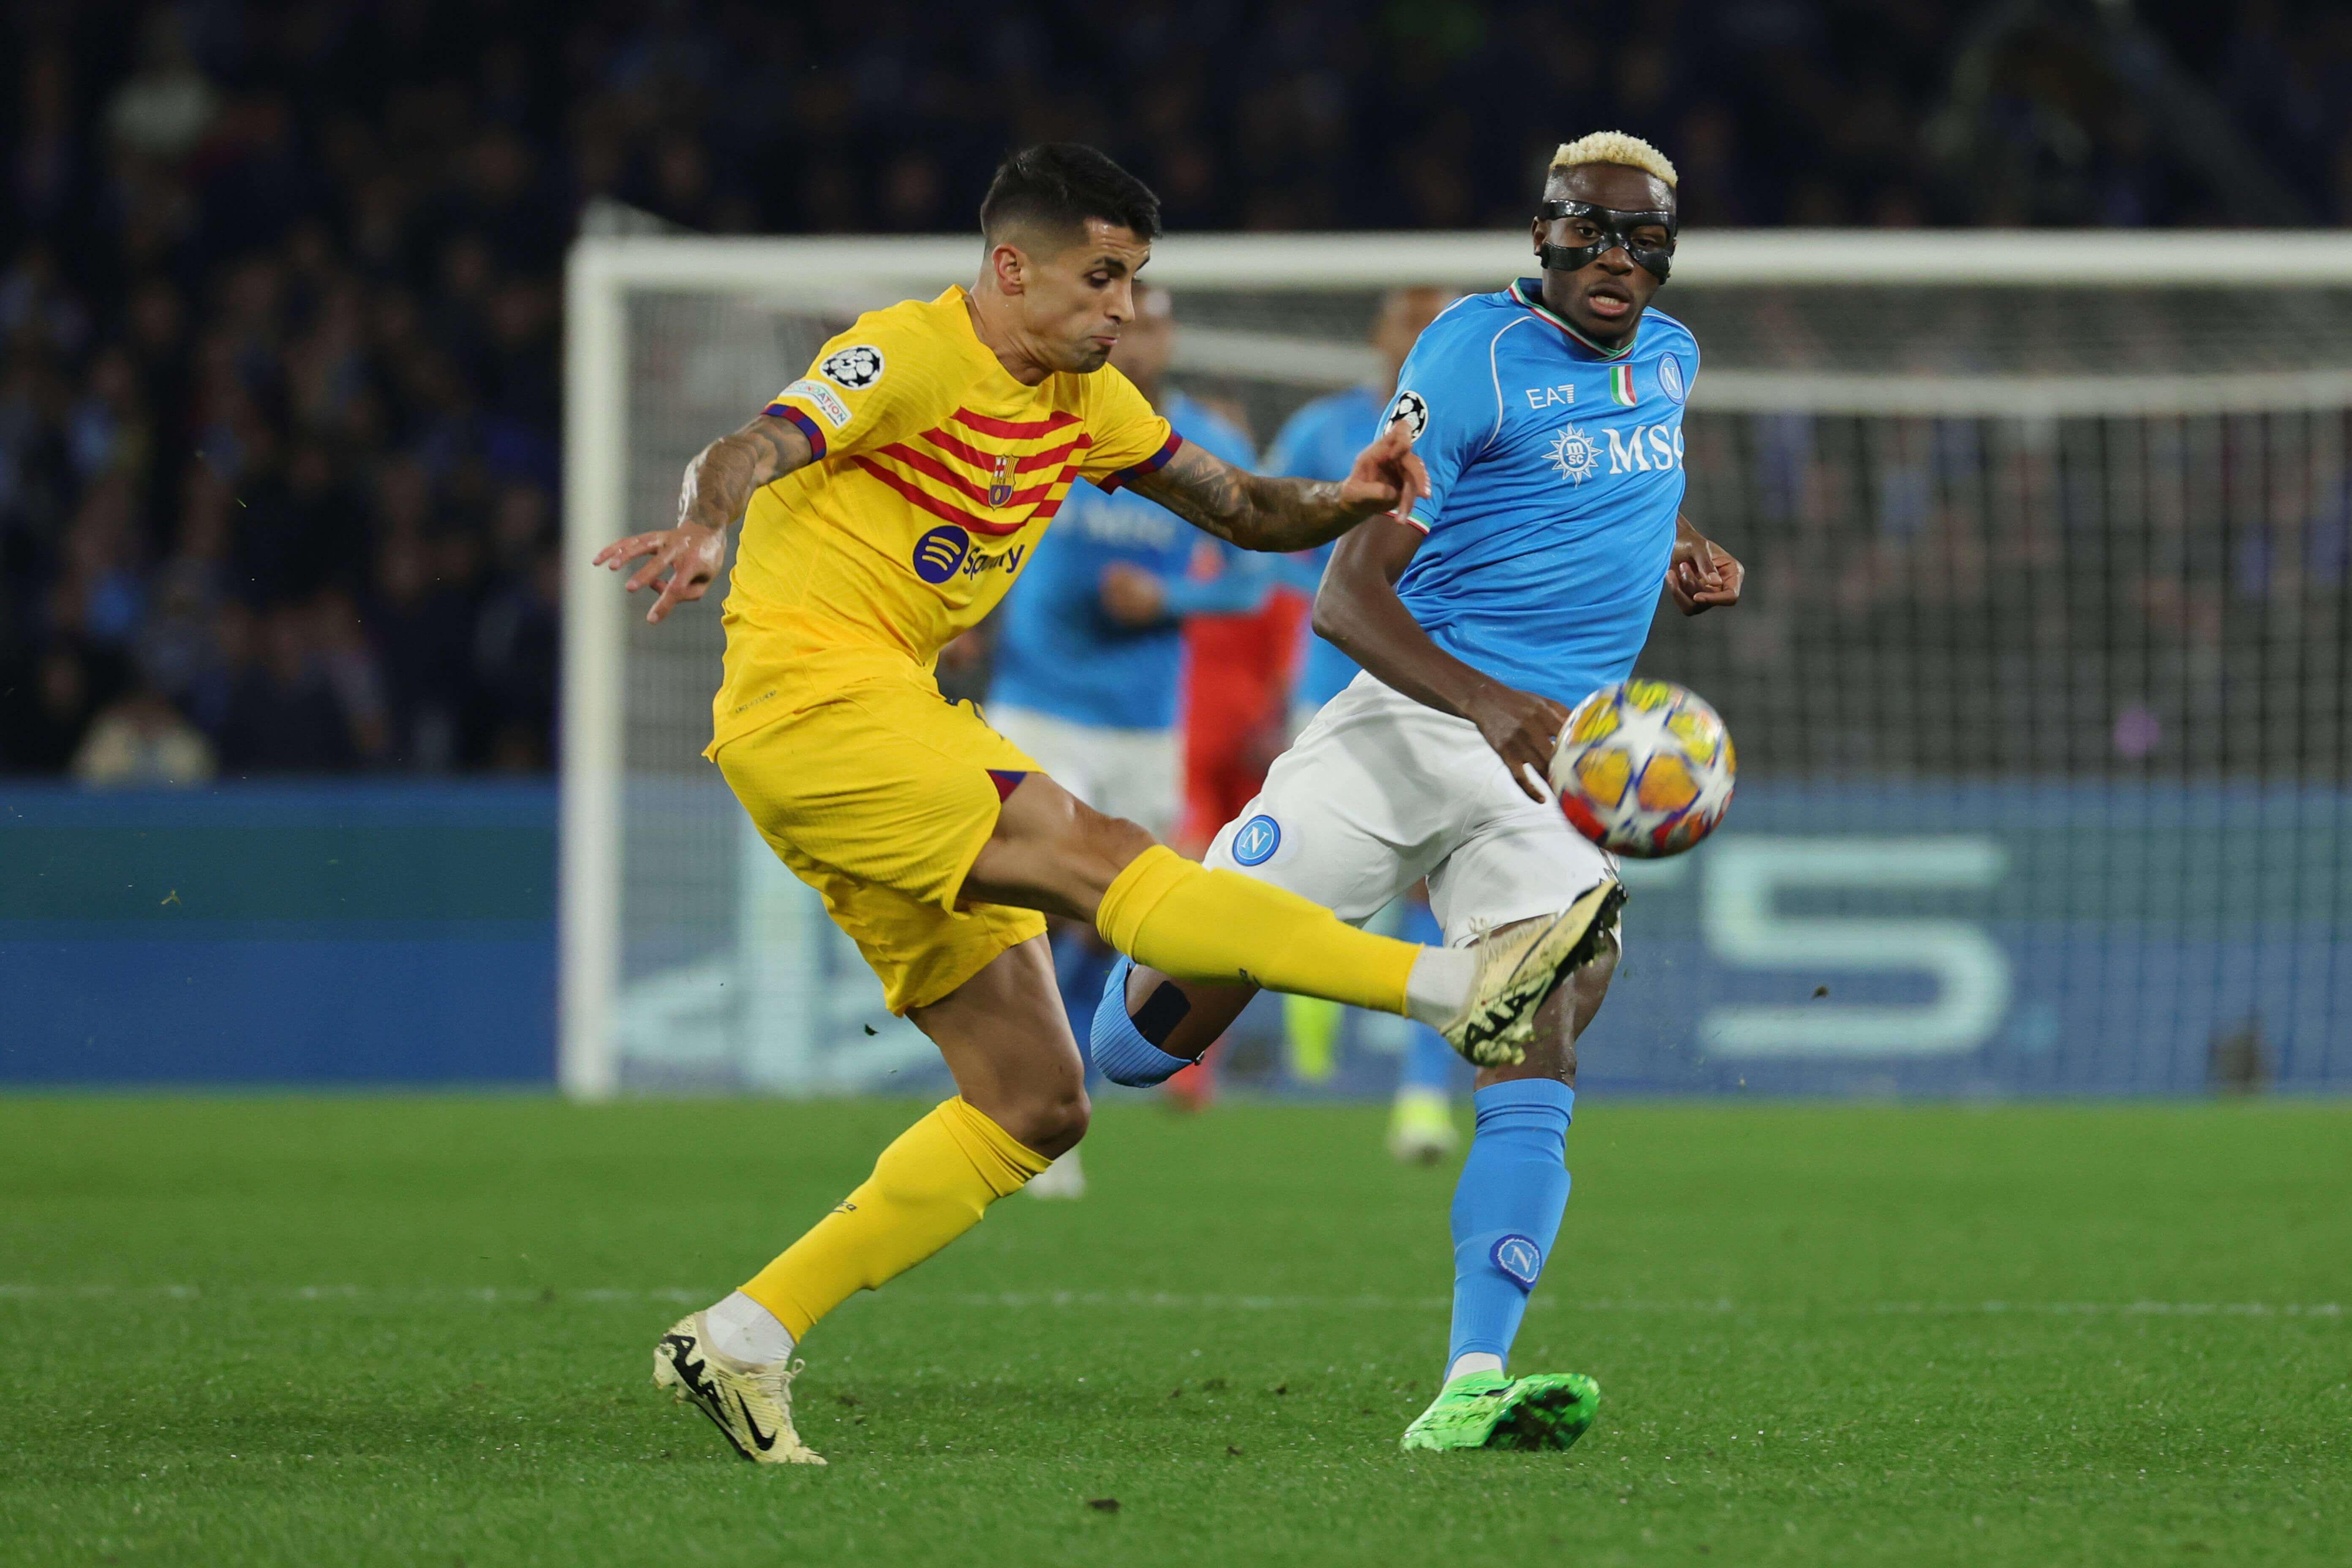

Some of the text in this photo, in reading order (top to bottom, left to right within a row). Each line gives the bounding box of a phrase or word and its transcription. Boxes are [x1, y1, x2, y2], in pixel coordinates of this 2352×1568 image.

[1663, 367, 1678, 391] N
[1525, 384, 1575, 409] EA7
[963, 544, 1025, 581] Spfy
[1241, 826, 1269, 853] N
[1508, 1245, 1533, 1273] N
